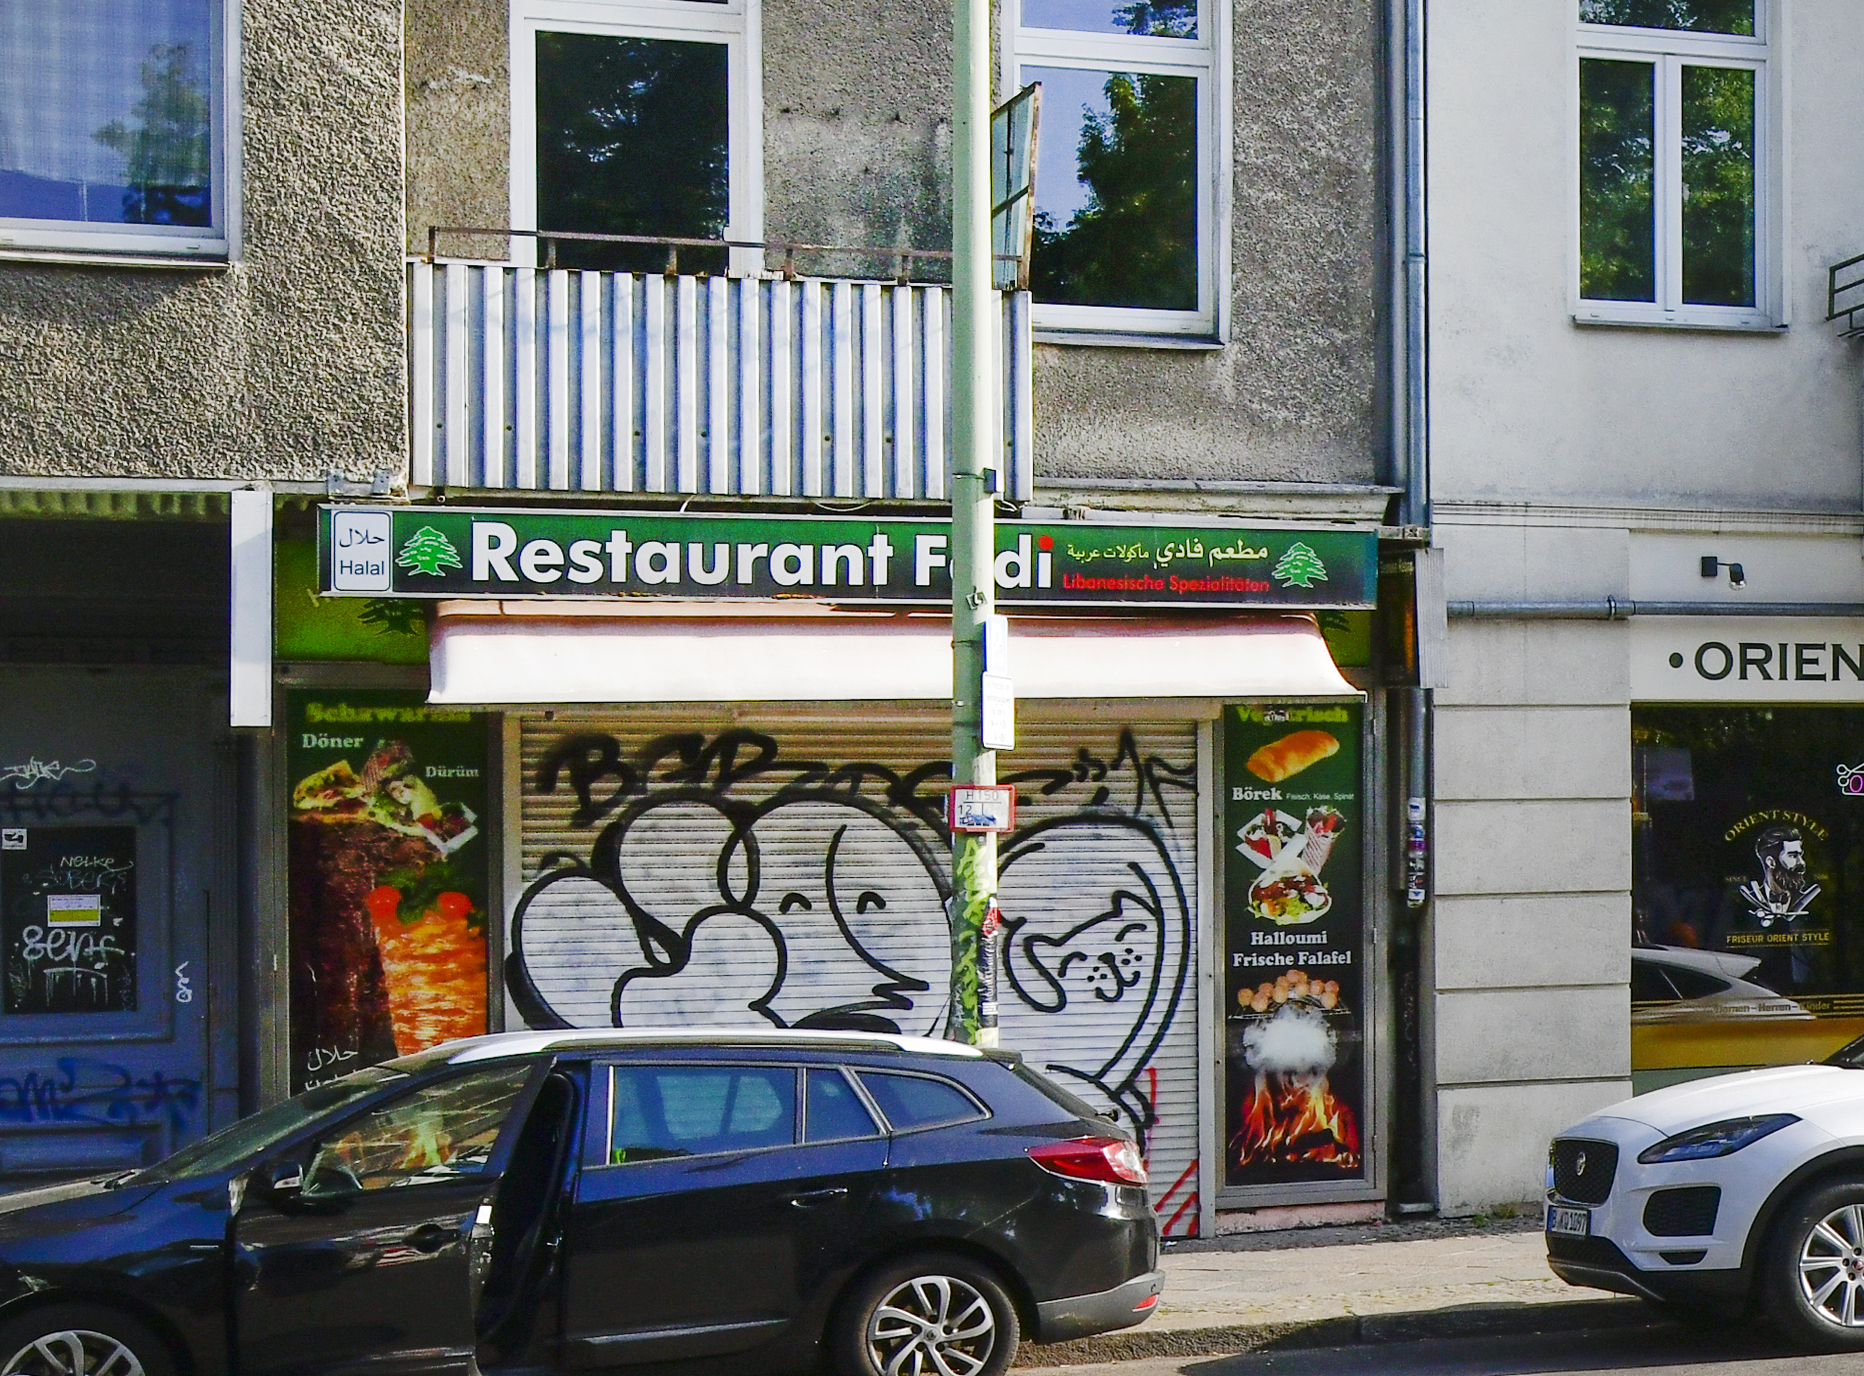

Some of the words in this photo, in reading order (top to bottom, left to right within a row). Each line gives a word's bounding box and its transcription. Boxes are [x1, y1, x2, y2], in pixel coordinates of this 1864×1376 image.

[471, 520, 893, 587] Restaurant
[914, 533, 1054, 589] Fdi
[340, 559, 385, 576] Halal
[1063, 573, 1165, 591] Libanesische
[1170, 575, 1270, 594] Spezialitäten
[302, 733, 364, 749] Döner
[425, 765, 479, 778] Dürüm
[1232, 787, 1283, 800] Börek
[1724, 810, 1780, 842] ORIENT
[1782, 811, 1829, 841] STYLE
[1250, 931, 1328, 945] Halloumi
[1726, 935, 1764, 943] FRISEUR
[1766, 934, 1799, 943] ORIENT
[1802, 932, 1829, 941] STYLE
[1233, 953, 1294, 967] Frische
[1297, 951, 1351, 965] Falafel
